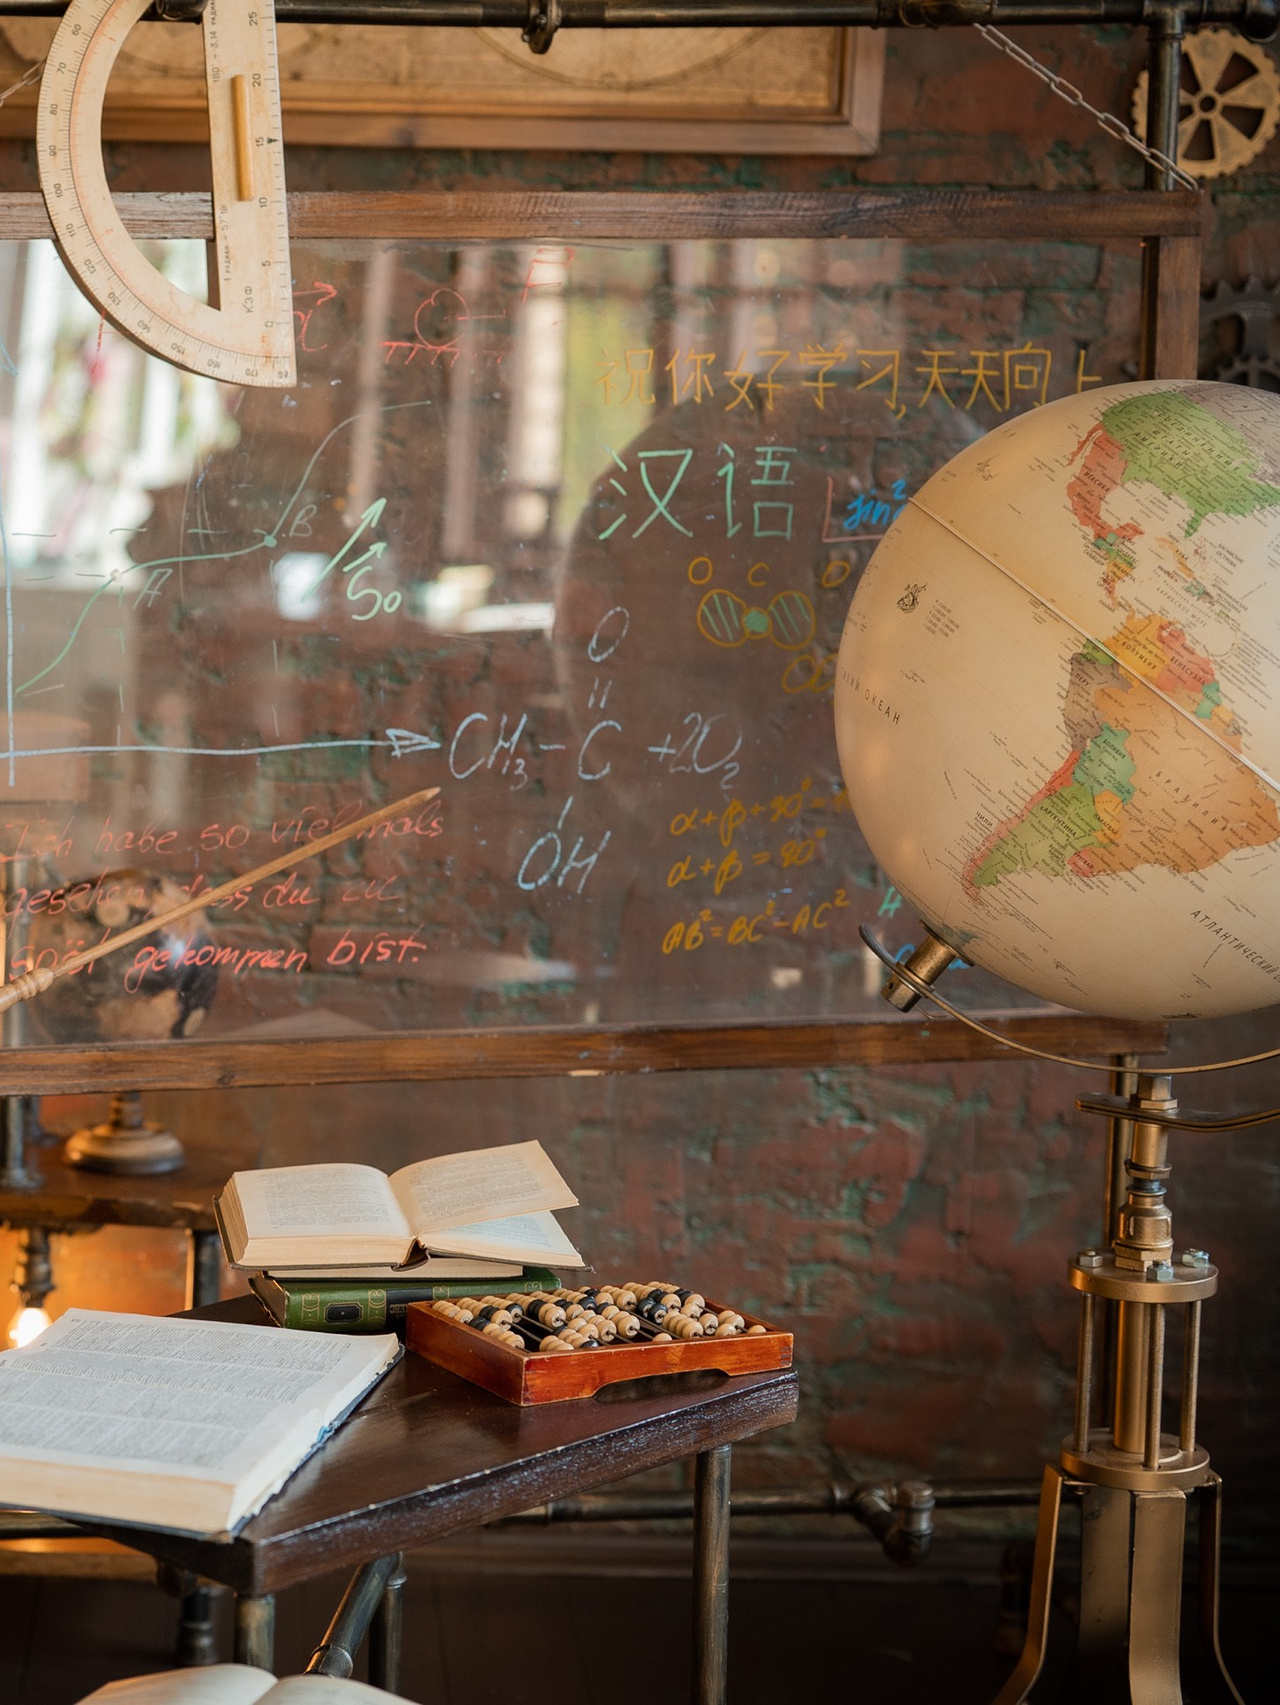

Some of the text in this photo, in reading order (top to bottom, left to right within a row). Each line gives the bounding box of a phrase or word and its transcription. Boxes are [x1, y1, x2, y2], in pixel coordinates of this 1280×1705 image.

[248, 11, 258, 26] 25
[72, 23, 82, 36] 60
[57, 62, 67, 75] 70
[252, 73, 261, 87] 20
[49, 103, 58, 116] 80
[255, 136, 264, 147] 15
[49, 144, 57, 157] 90
[53, 183, 64, 198] 100
[258, 197, 268, 208] 10
[66, 223, 78, 238] 110
[84, 258, 98, 275] 120
[108, 291, 122, 306] 130
[137, 319, 152, 334] 140
[170, 342, 186, 356] 150
[245, 367, 259, 378] 170
[1083, 471, 1110, 492] МЕКСИКА
[598, 443, 797, 541] 汉语
[1155, 587, 1207, 626] КАРИБСКОЕ МОРЕ
[1121, 641, 1157, 669] КОЛУМБИЯ
[1169, 656, 1206, 685] ВЕНЕСУЭЛА
[1075, 673, 1089, 686] ПЕРУ
[864, 688, 901, 725] ОКЕАН
[1103, 739, 1126, 758] БОЛИВИЯ
[1154, 770, 1228, 831] БРАЗИЛИЯ
[975, 811, 993, 826] ЧИЛИ
[1042, 807, 1077, 836] АРГЕНТИНА
[1092, 813, 1118, 835] ПАРАГВАЙ
[95, 812, 179, 855] habe
[262, 871, 320, 909] du
[1189, 910, 1280, 975] АТЛАНТИЧЕСКИЙ
